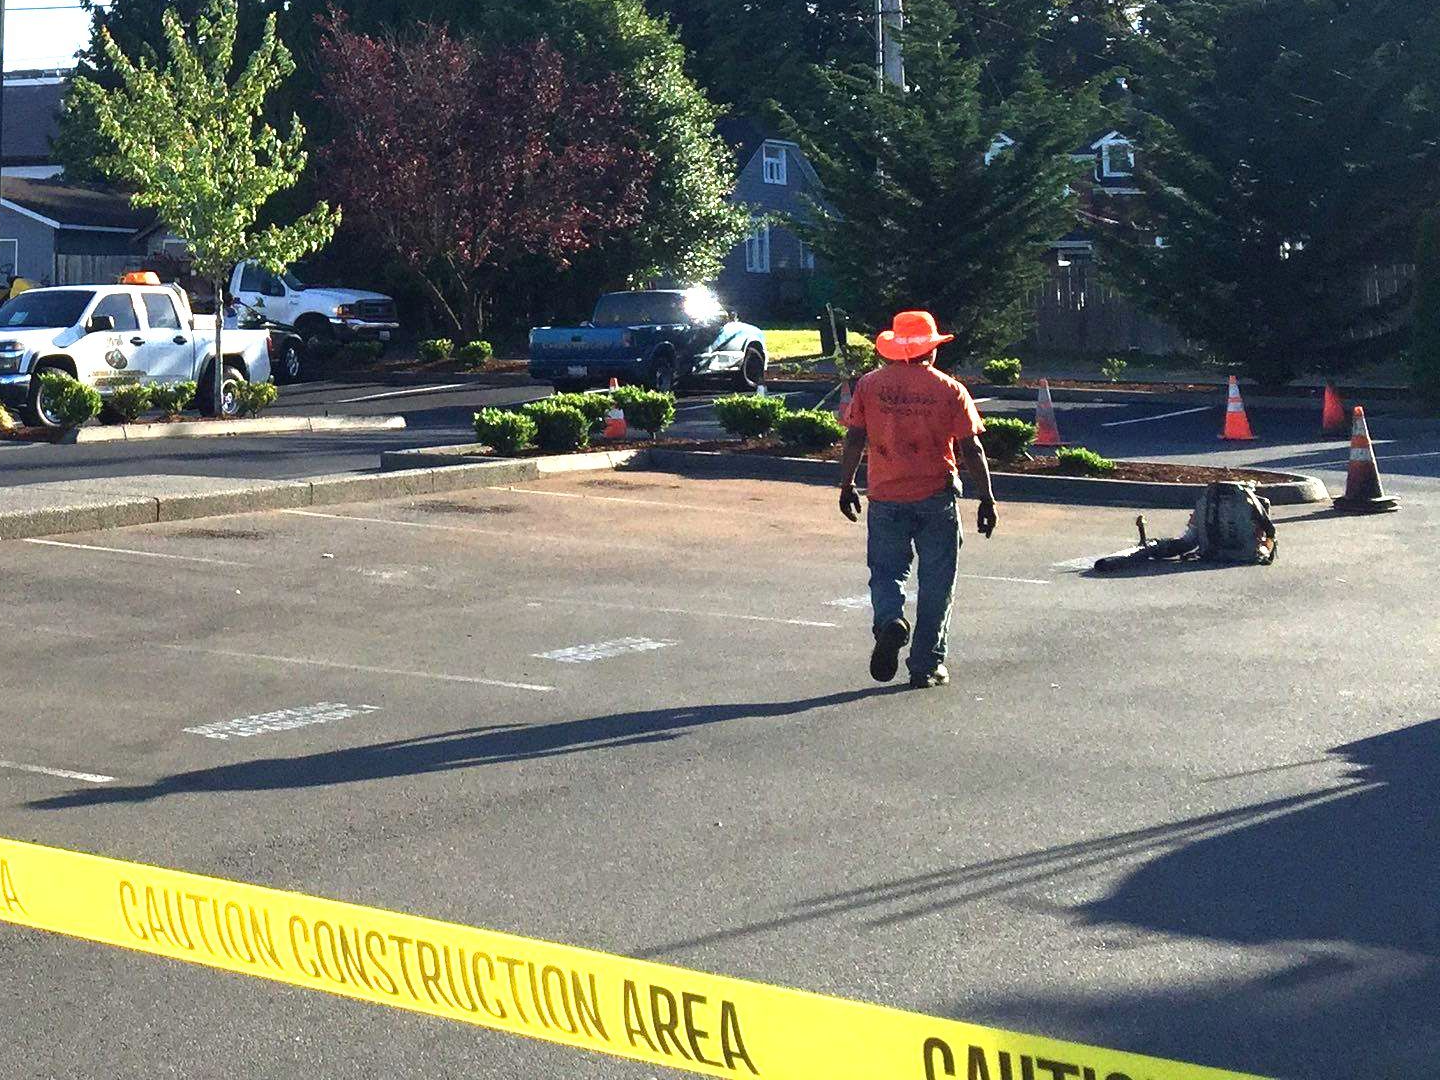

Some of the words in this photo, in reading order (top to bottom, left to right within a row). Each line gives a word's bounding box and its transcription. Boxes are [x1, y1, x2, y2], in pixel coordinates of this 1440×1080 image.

[119, 880, 282, 970] CAUTION
[289, 915, 610, 1044] CONSTRUCTION
[622, 978, 760, 1076] AREA
